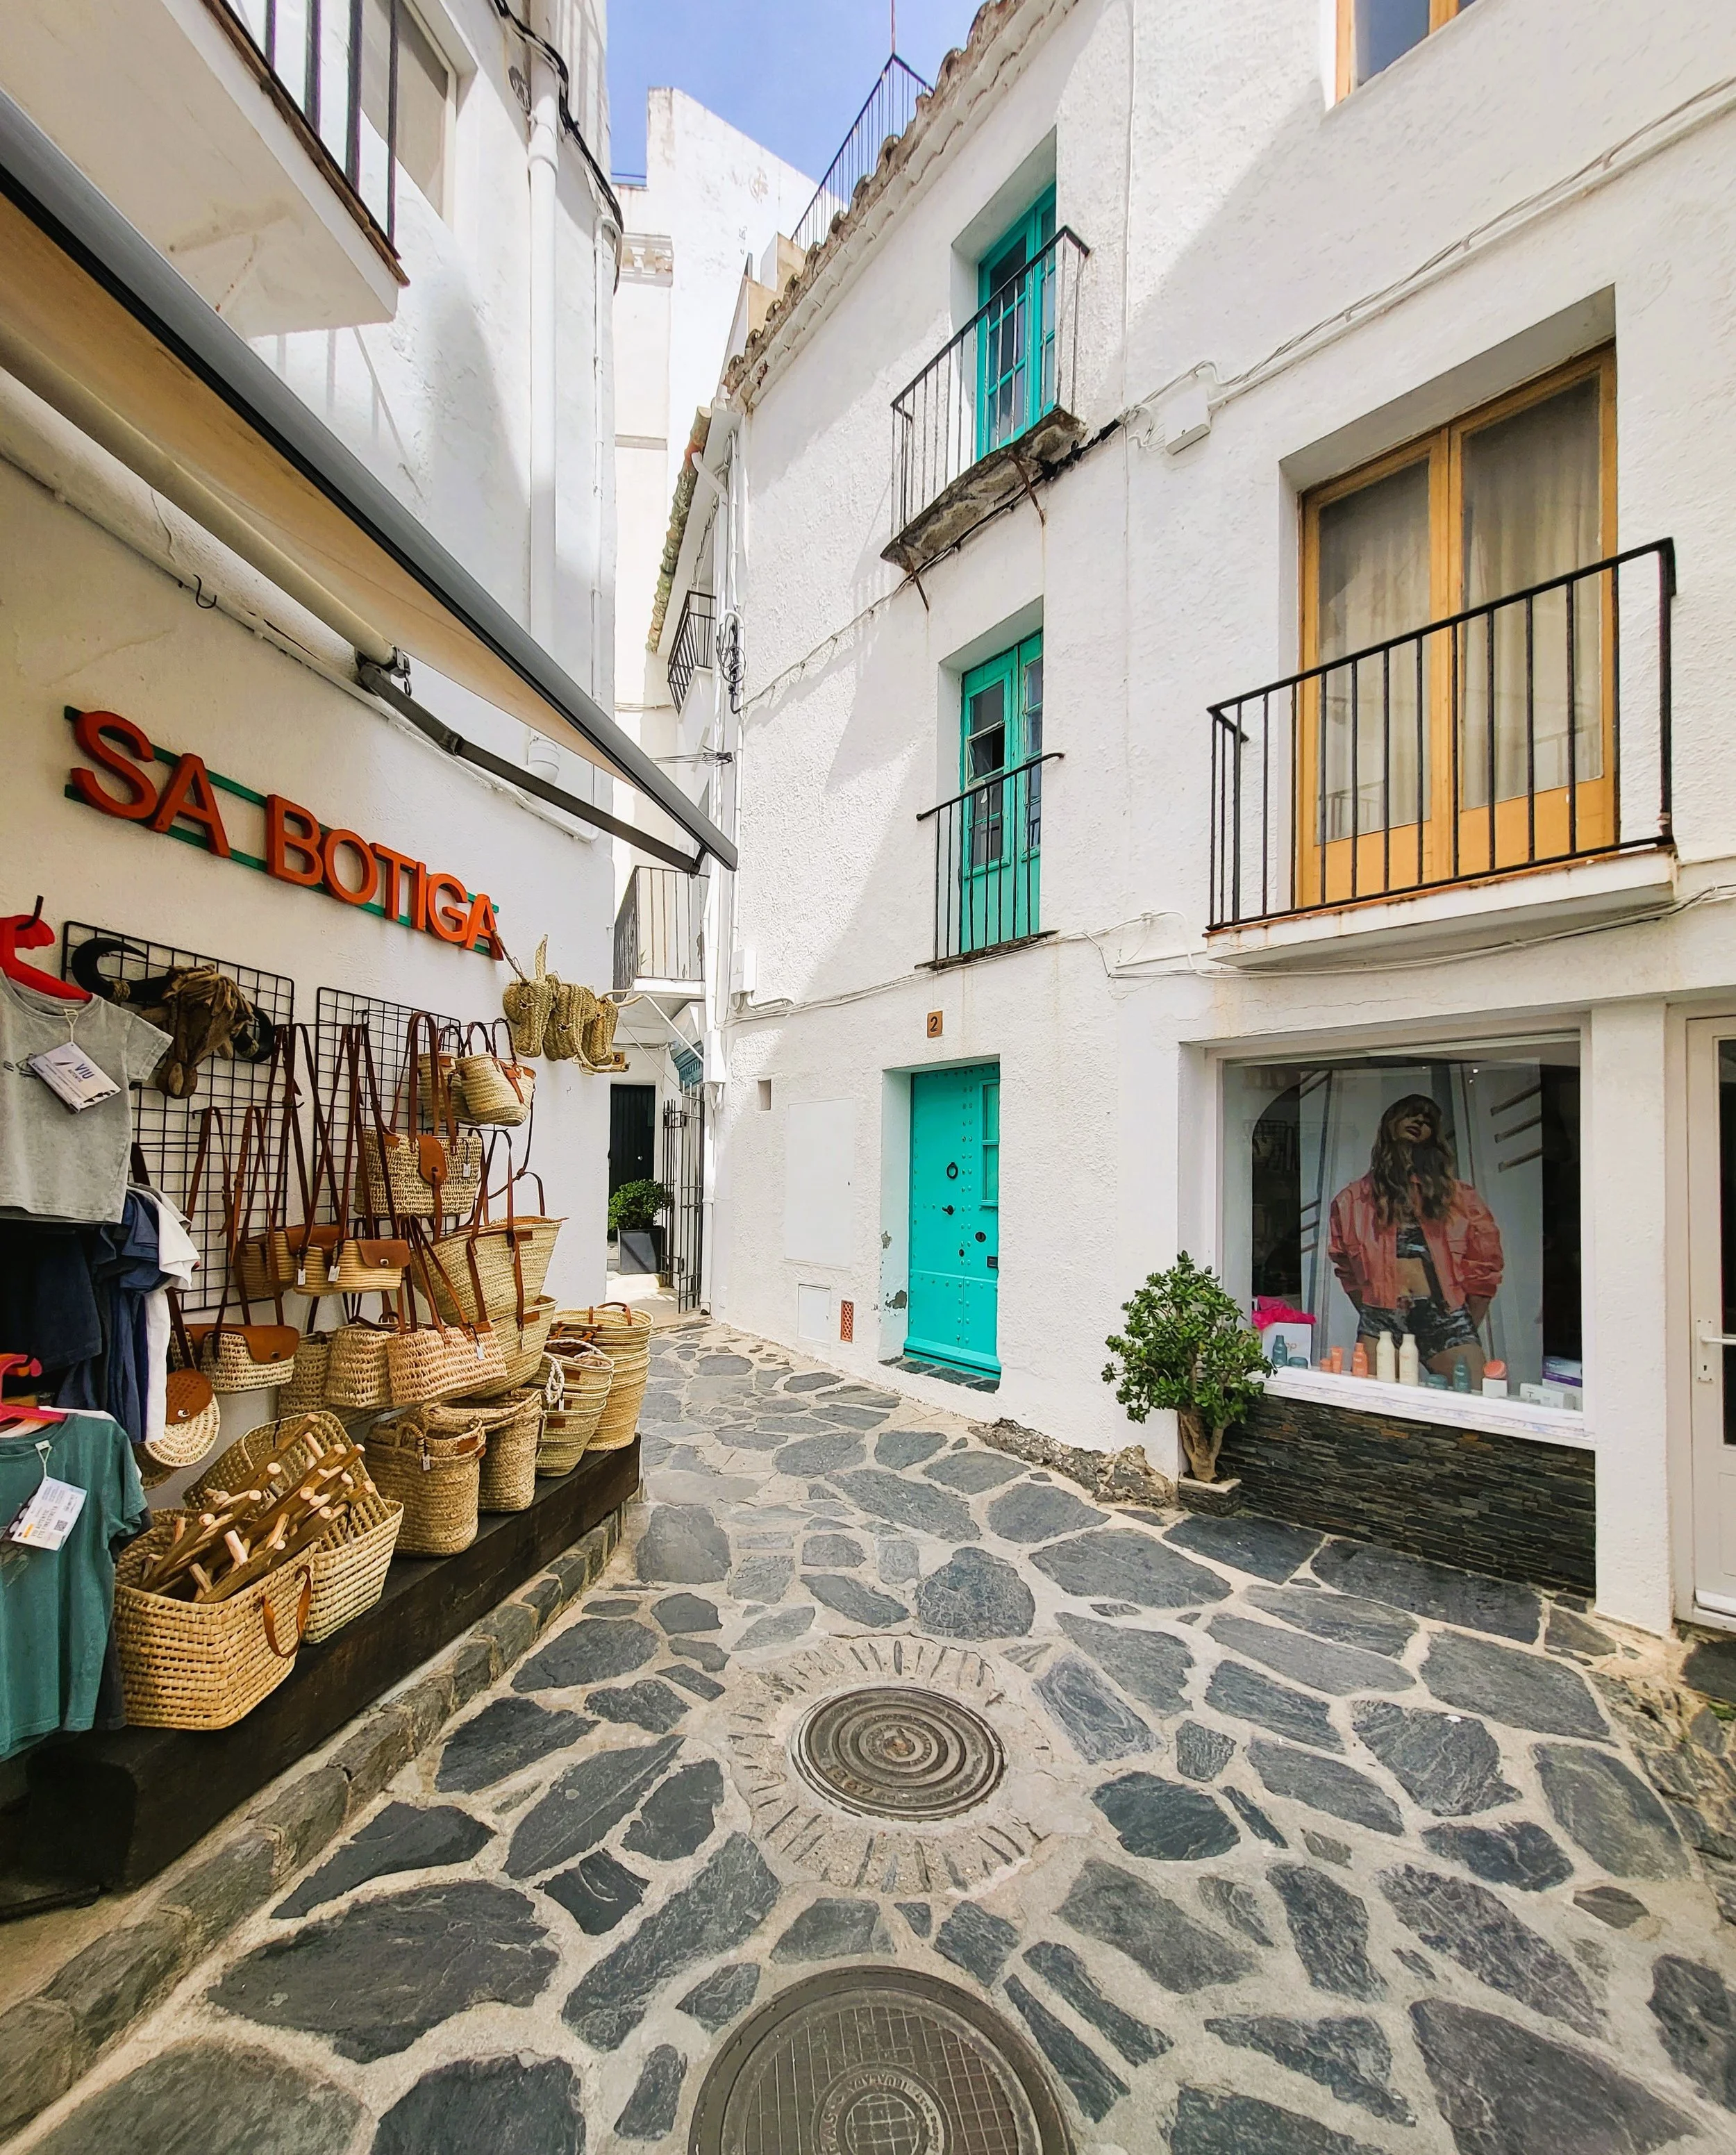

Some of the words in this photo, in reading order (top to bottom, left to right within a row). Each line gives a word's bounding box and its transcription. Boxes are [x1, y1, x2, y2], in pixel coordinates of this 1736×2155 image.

[70, 710, 231, 858] SA
[267, 794, 503, 961] BOTIGA
[930, 1015, 938, 1033] 2
[614, 1054, 621, 1063] 6
[74, 1063, 95, 1079] VIU
